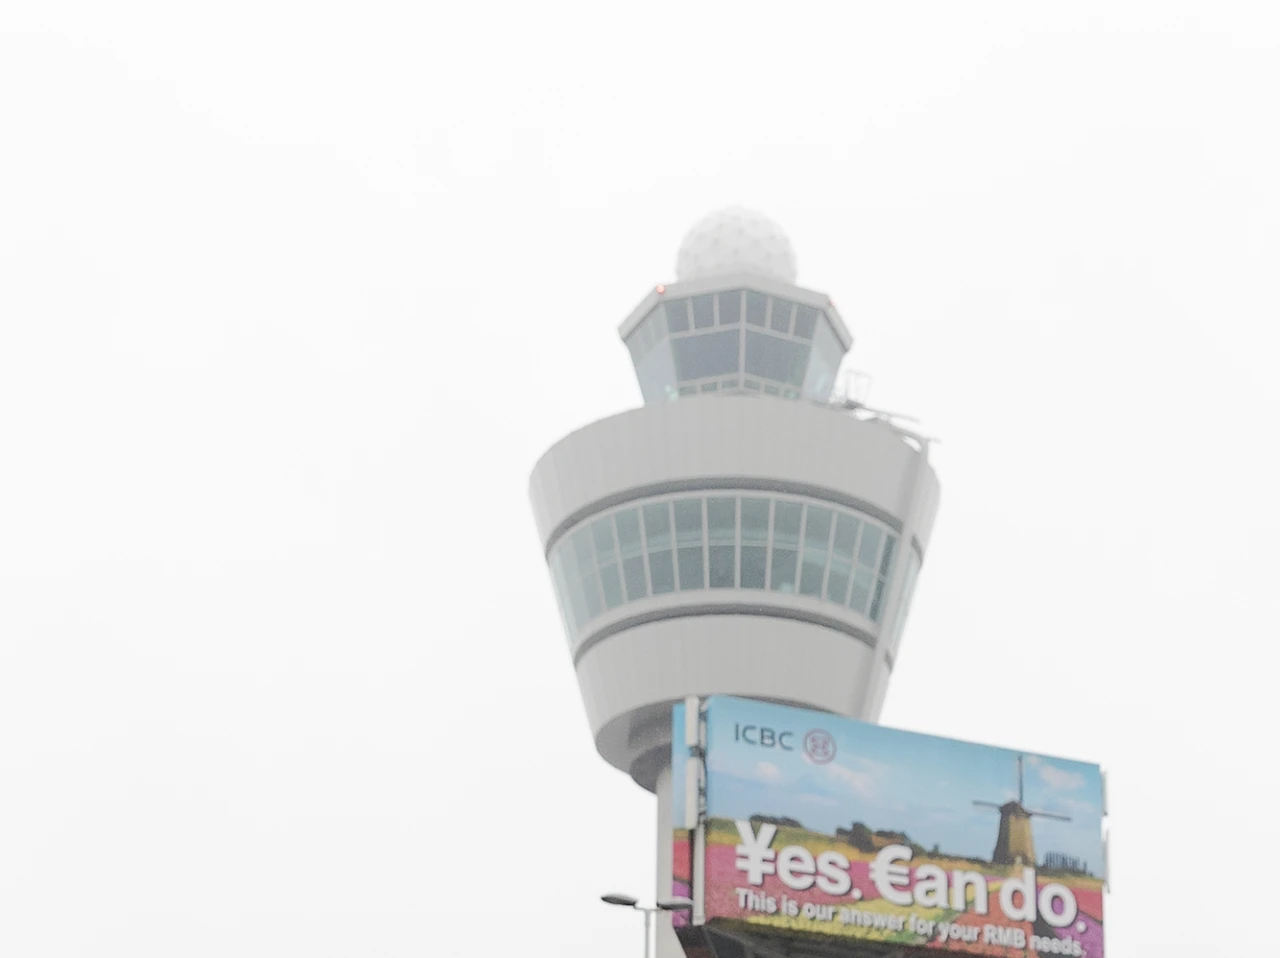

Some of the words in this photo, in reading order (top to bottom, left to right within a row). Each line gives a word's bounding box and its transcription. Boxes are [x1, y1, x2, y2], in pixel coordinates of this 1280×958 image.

[734, 723, 795, 751] ICBC
[735, 887, 777, 914] This
[781, 894, 799, 916] is
[802, 901, 836, 921] our
[839, 907, 906, 931] answer
[908, 913, 936, 936] for
[937, 920, 980, 942] your
[982, 923, 1026, 949] RMB
[1029, 934, 1088, 957] needs.
[999, 866, 1087, 933] do.
